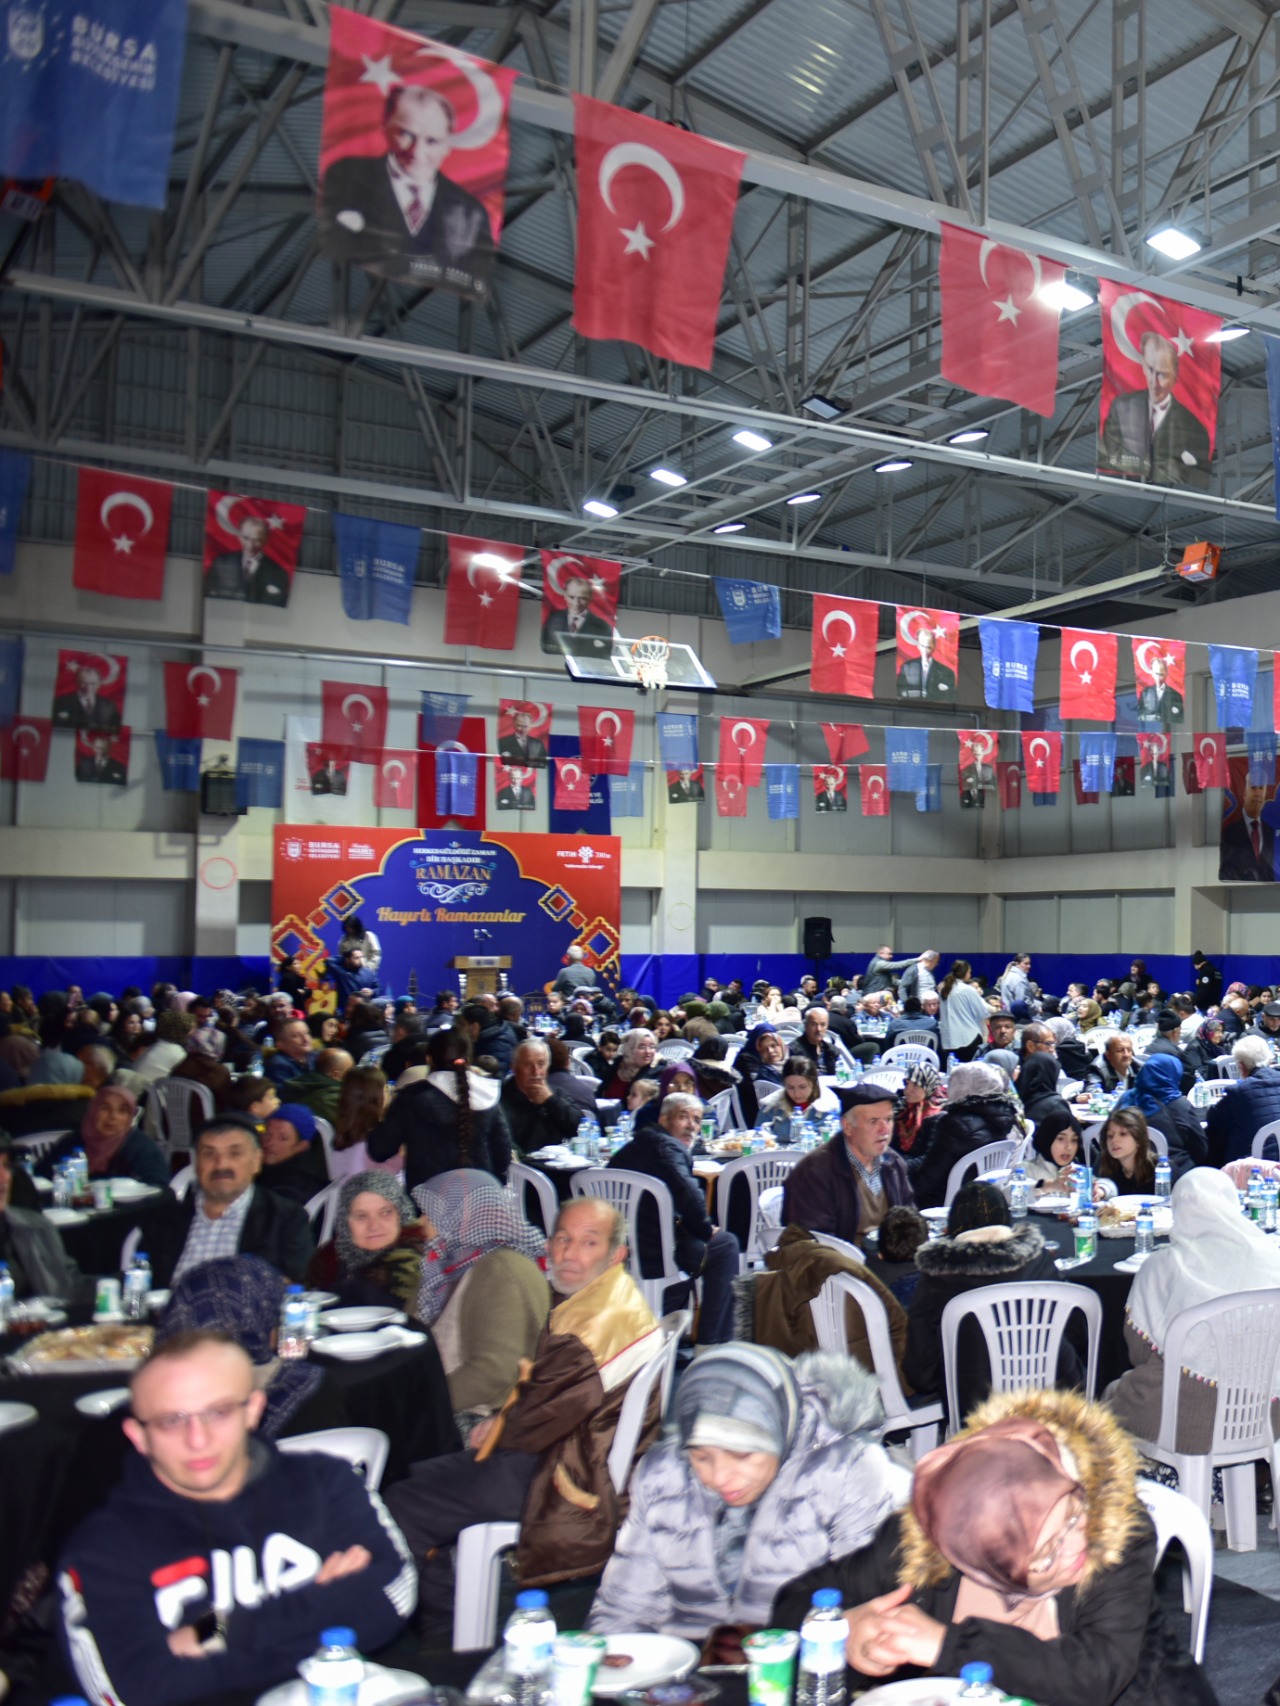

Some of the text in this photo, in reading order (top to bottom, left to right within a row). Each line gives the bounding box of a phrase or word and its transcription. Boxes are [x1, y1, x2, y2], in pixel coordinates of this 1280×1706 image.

[72, 14, 157, 62] BURSA
[415, 864, 492, 881] RAMAZAN
[376, 906, 528, 926] Hayırlı Ramazanlar
[151, 1532, 322, 1630] FILA
